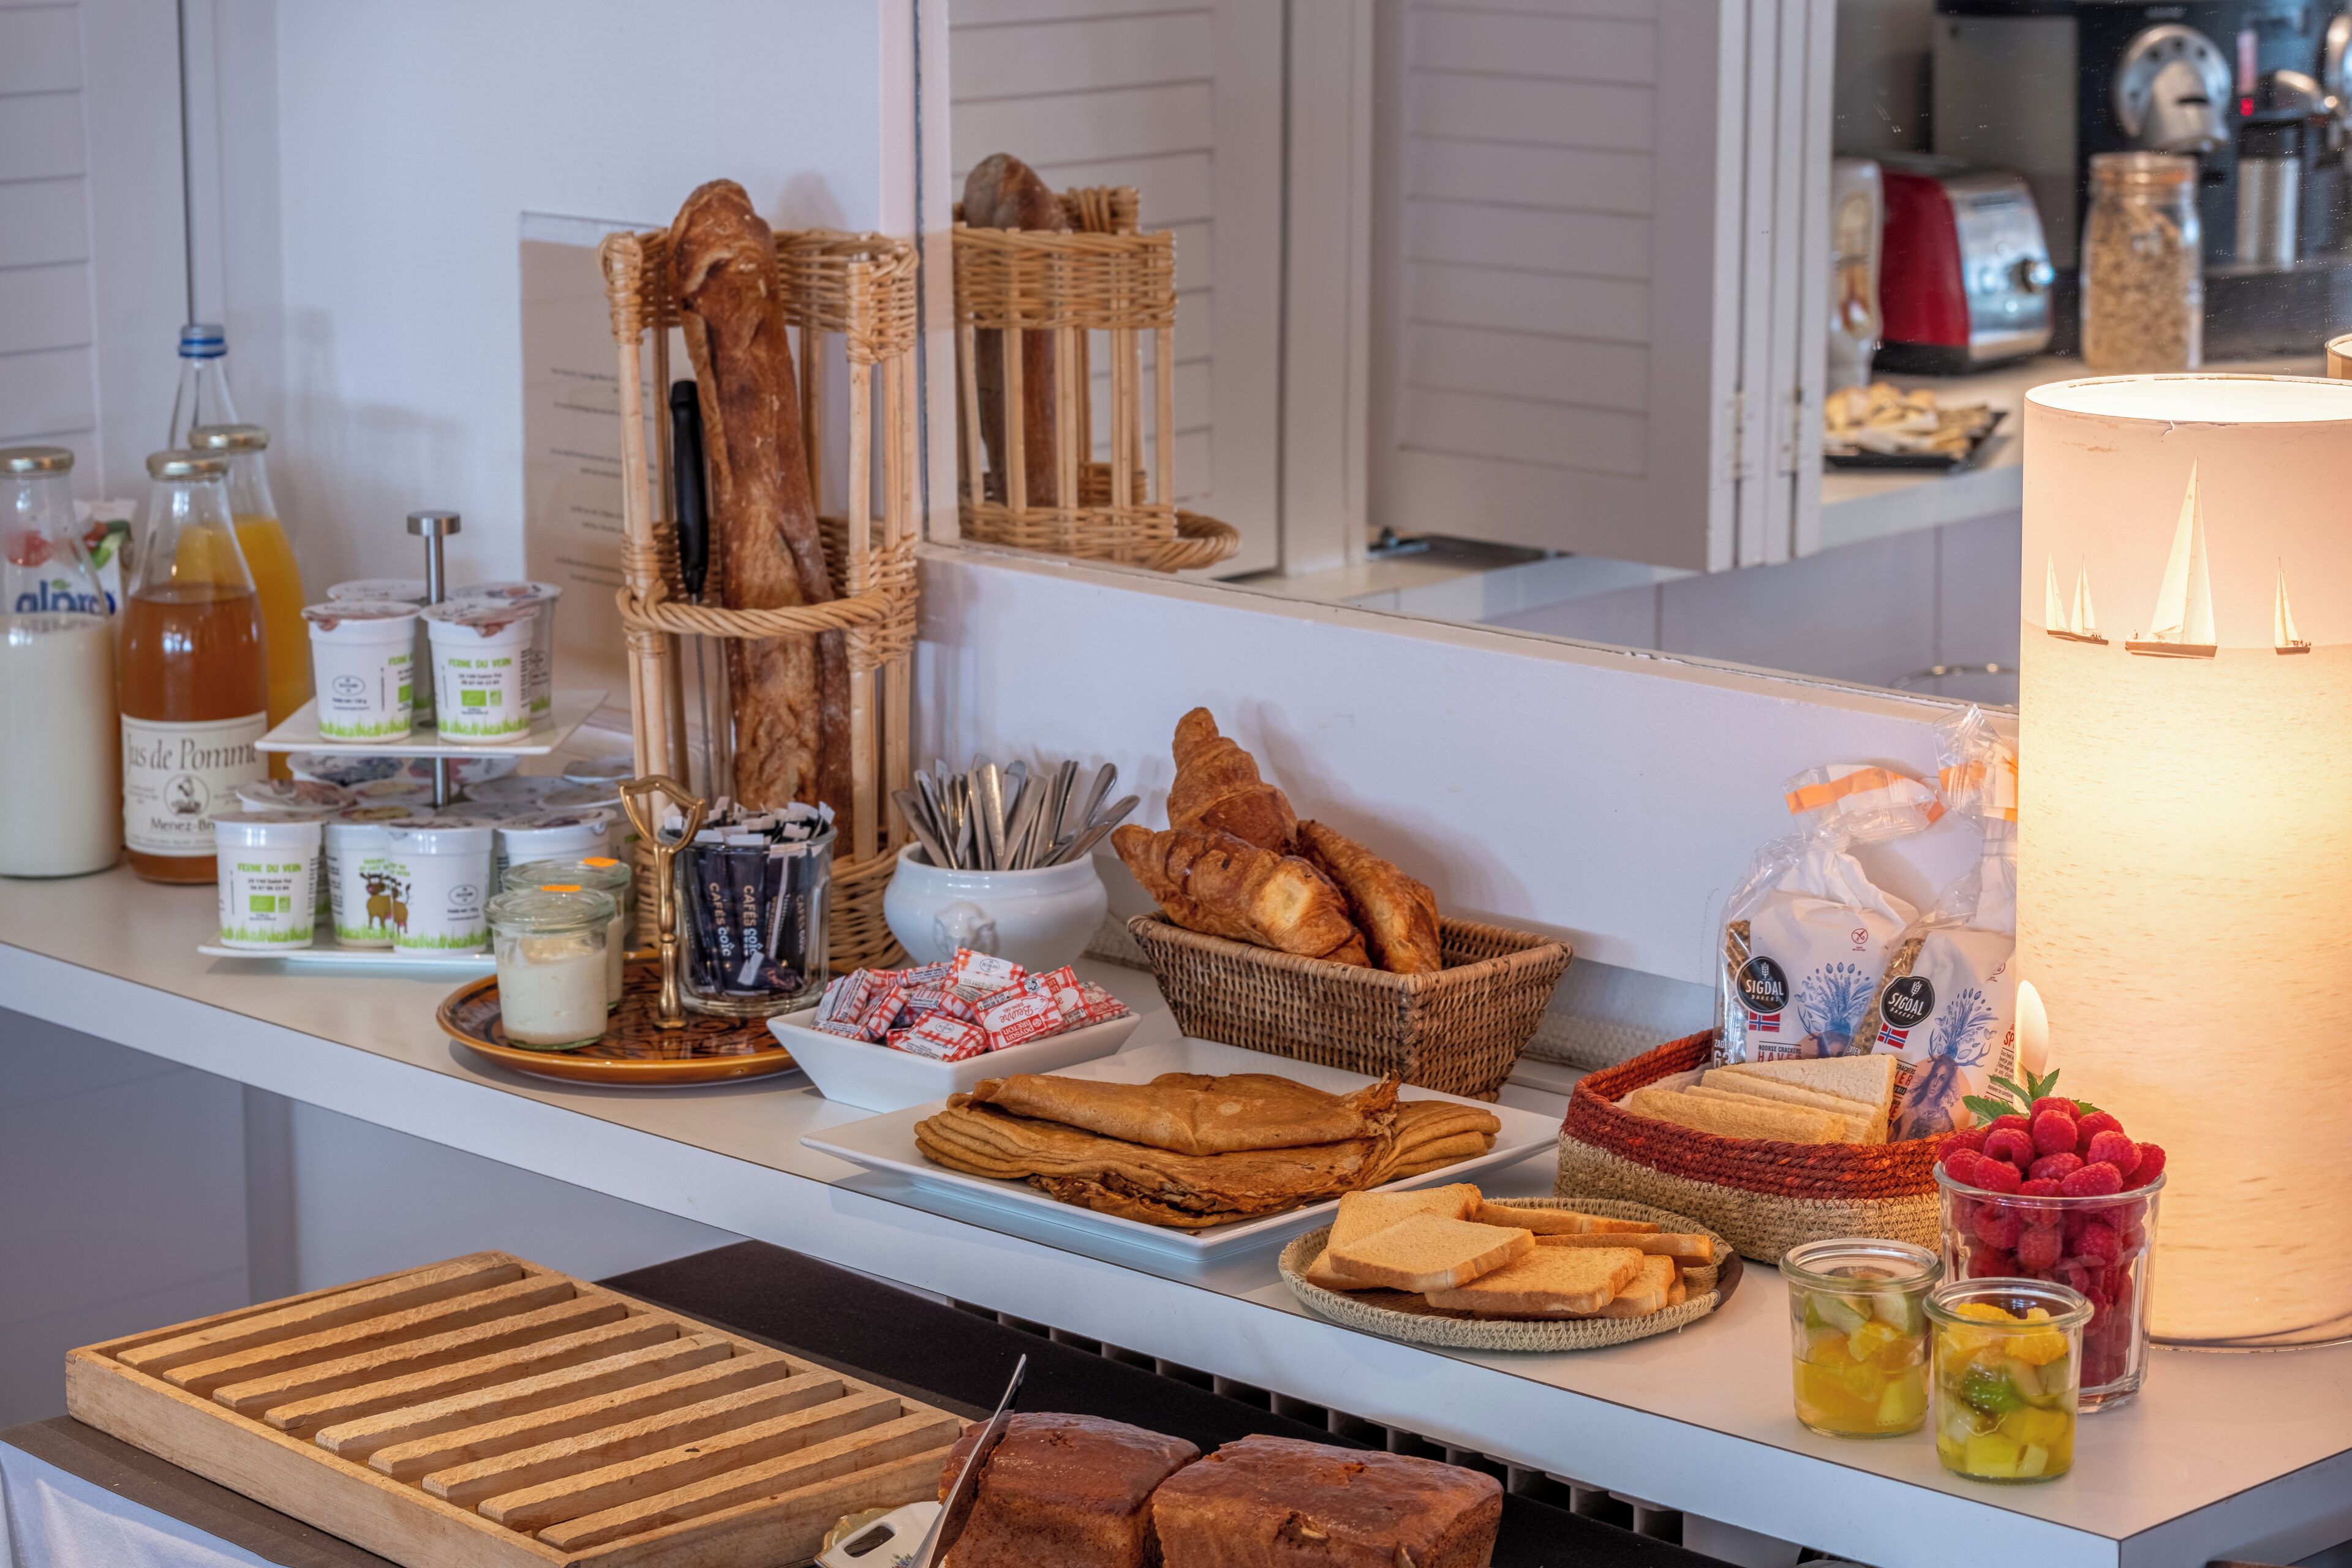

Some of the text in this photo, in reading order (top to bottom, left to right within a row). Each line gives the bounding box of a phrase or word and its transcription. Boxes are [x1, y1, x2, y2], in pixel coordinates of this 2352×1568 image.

[151, 739, 173, 771] de
[709, 882, 726, 925] CAFÉS
[743, 884, 758, 926] CAFÉS
[1746, 979, 1784, 996] SIGDAL
[1888, 992, 1924, 1016] SIGDAL
[999, 1005, 1033, 1023] Beurre
[1005, 1020, 1031, 1035] BRETON
[1006, 1026, 1035, 1041] paysan
[1714, 1039, 1732, 1050] ZADEN
